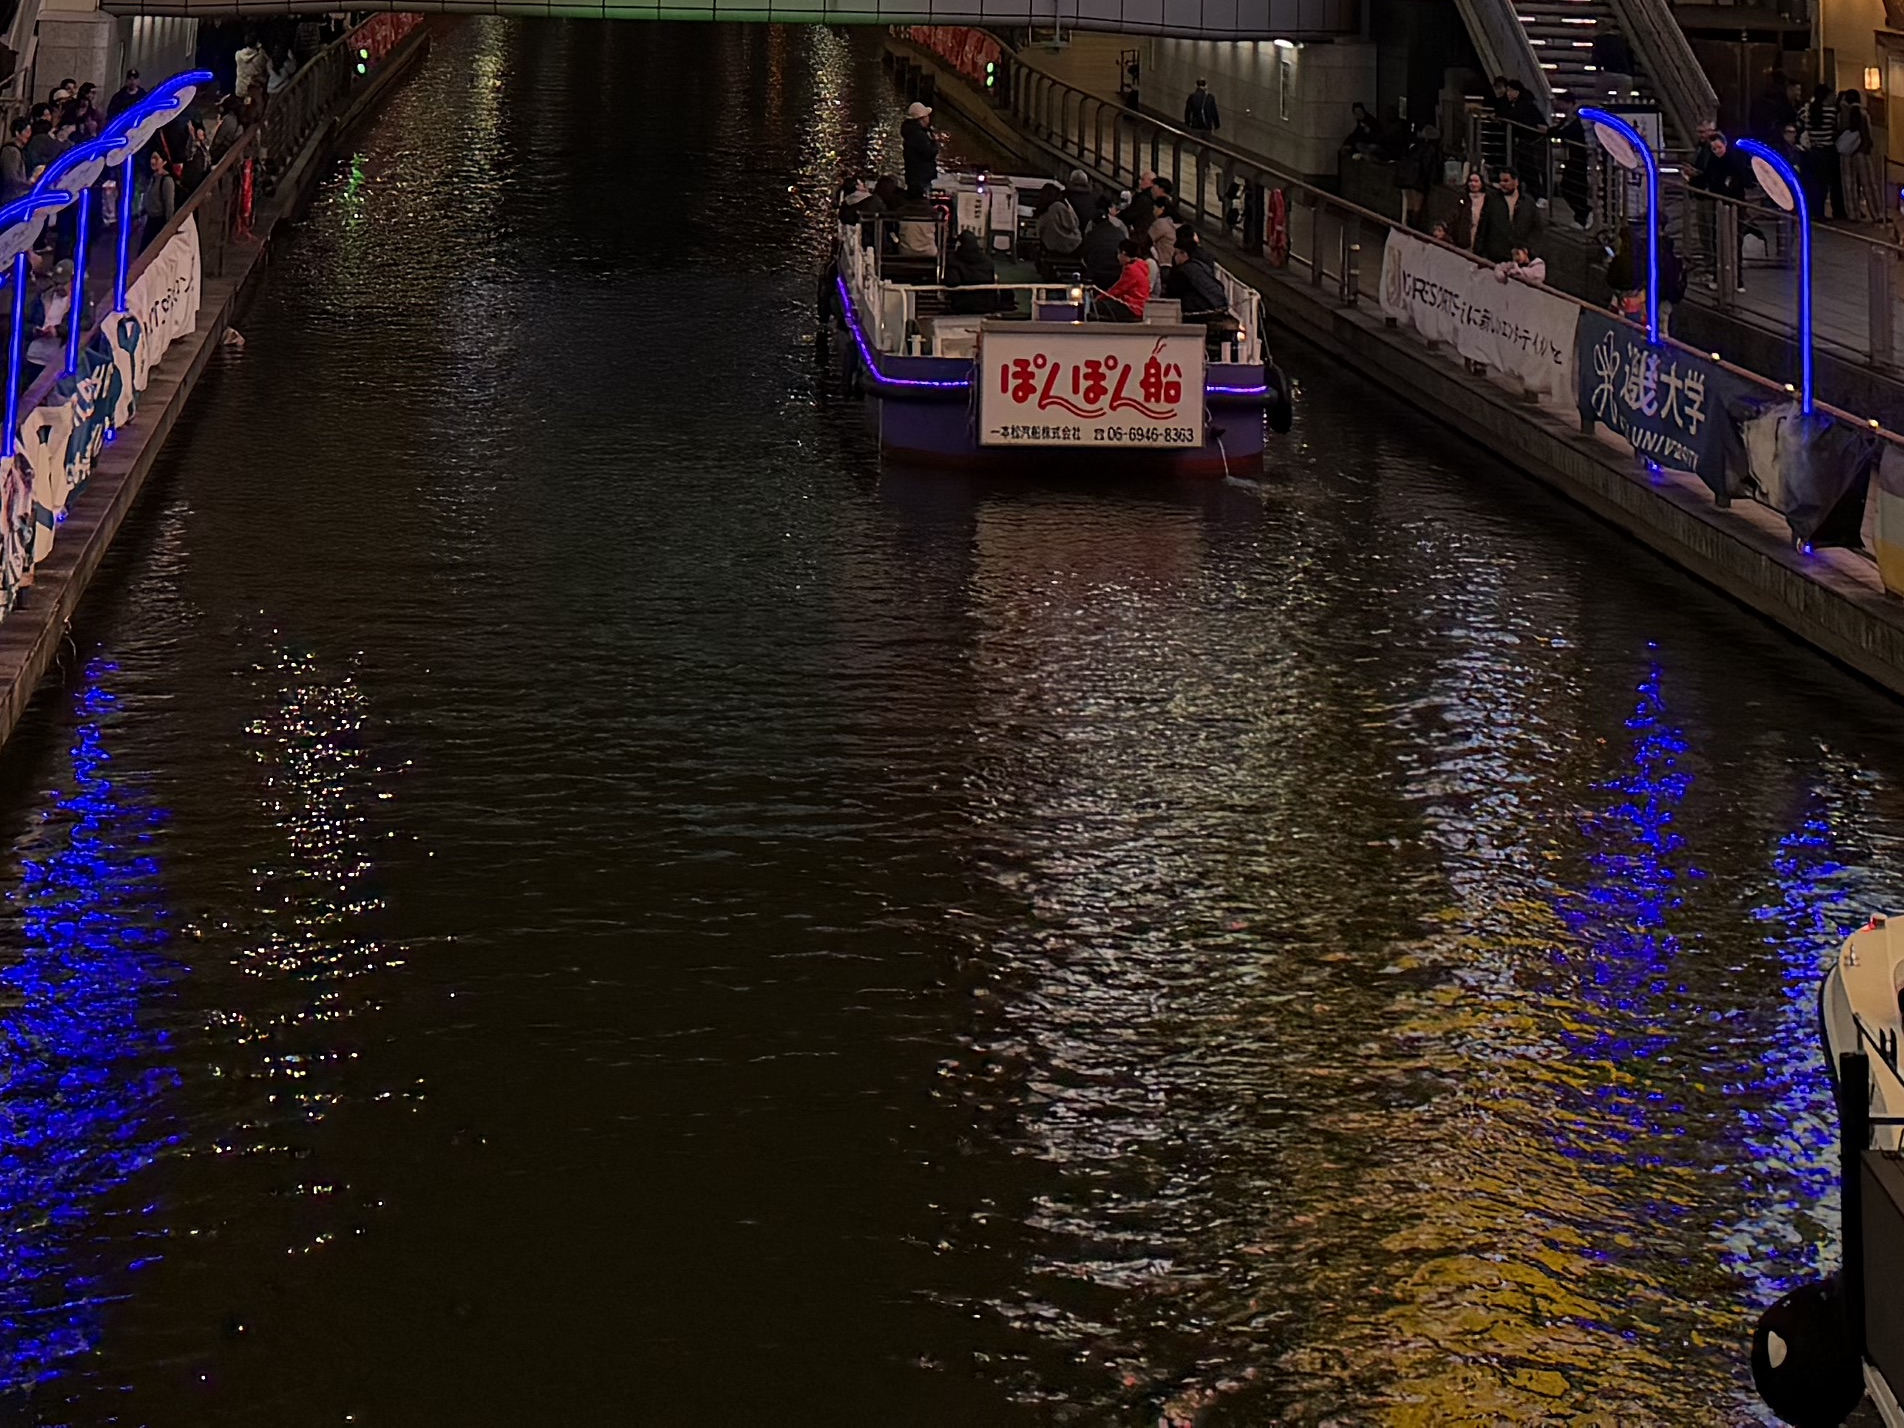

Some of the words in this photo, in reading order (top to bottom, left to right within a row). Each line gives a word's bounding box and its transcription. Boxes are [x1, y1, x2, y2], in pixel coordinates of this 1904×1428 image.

[1000, 344, 1183, 421] ぽんぽん船
[1107, 426, 1194, 443] 06-6946-8363
